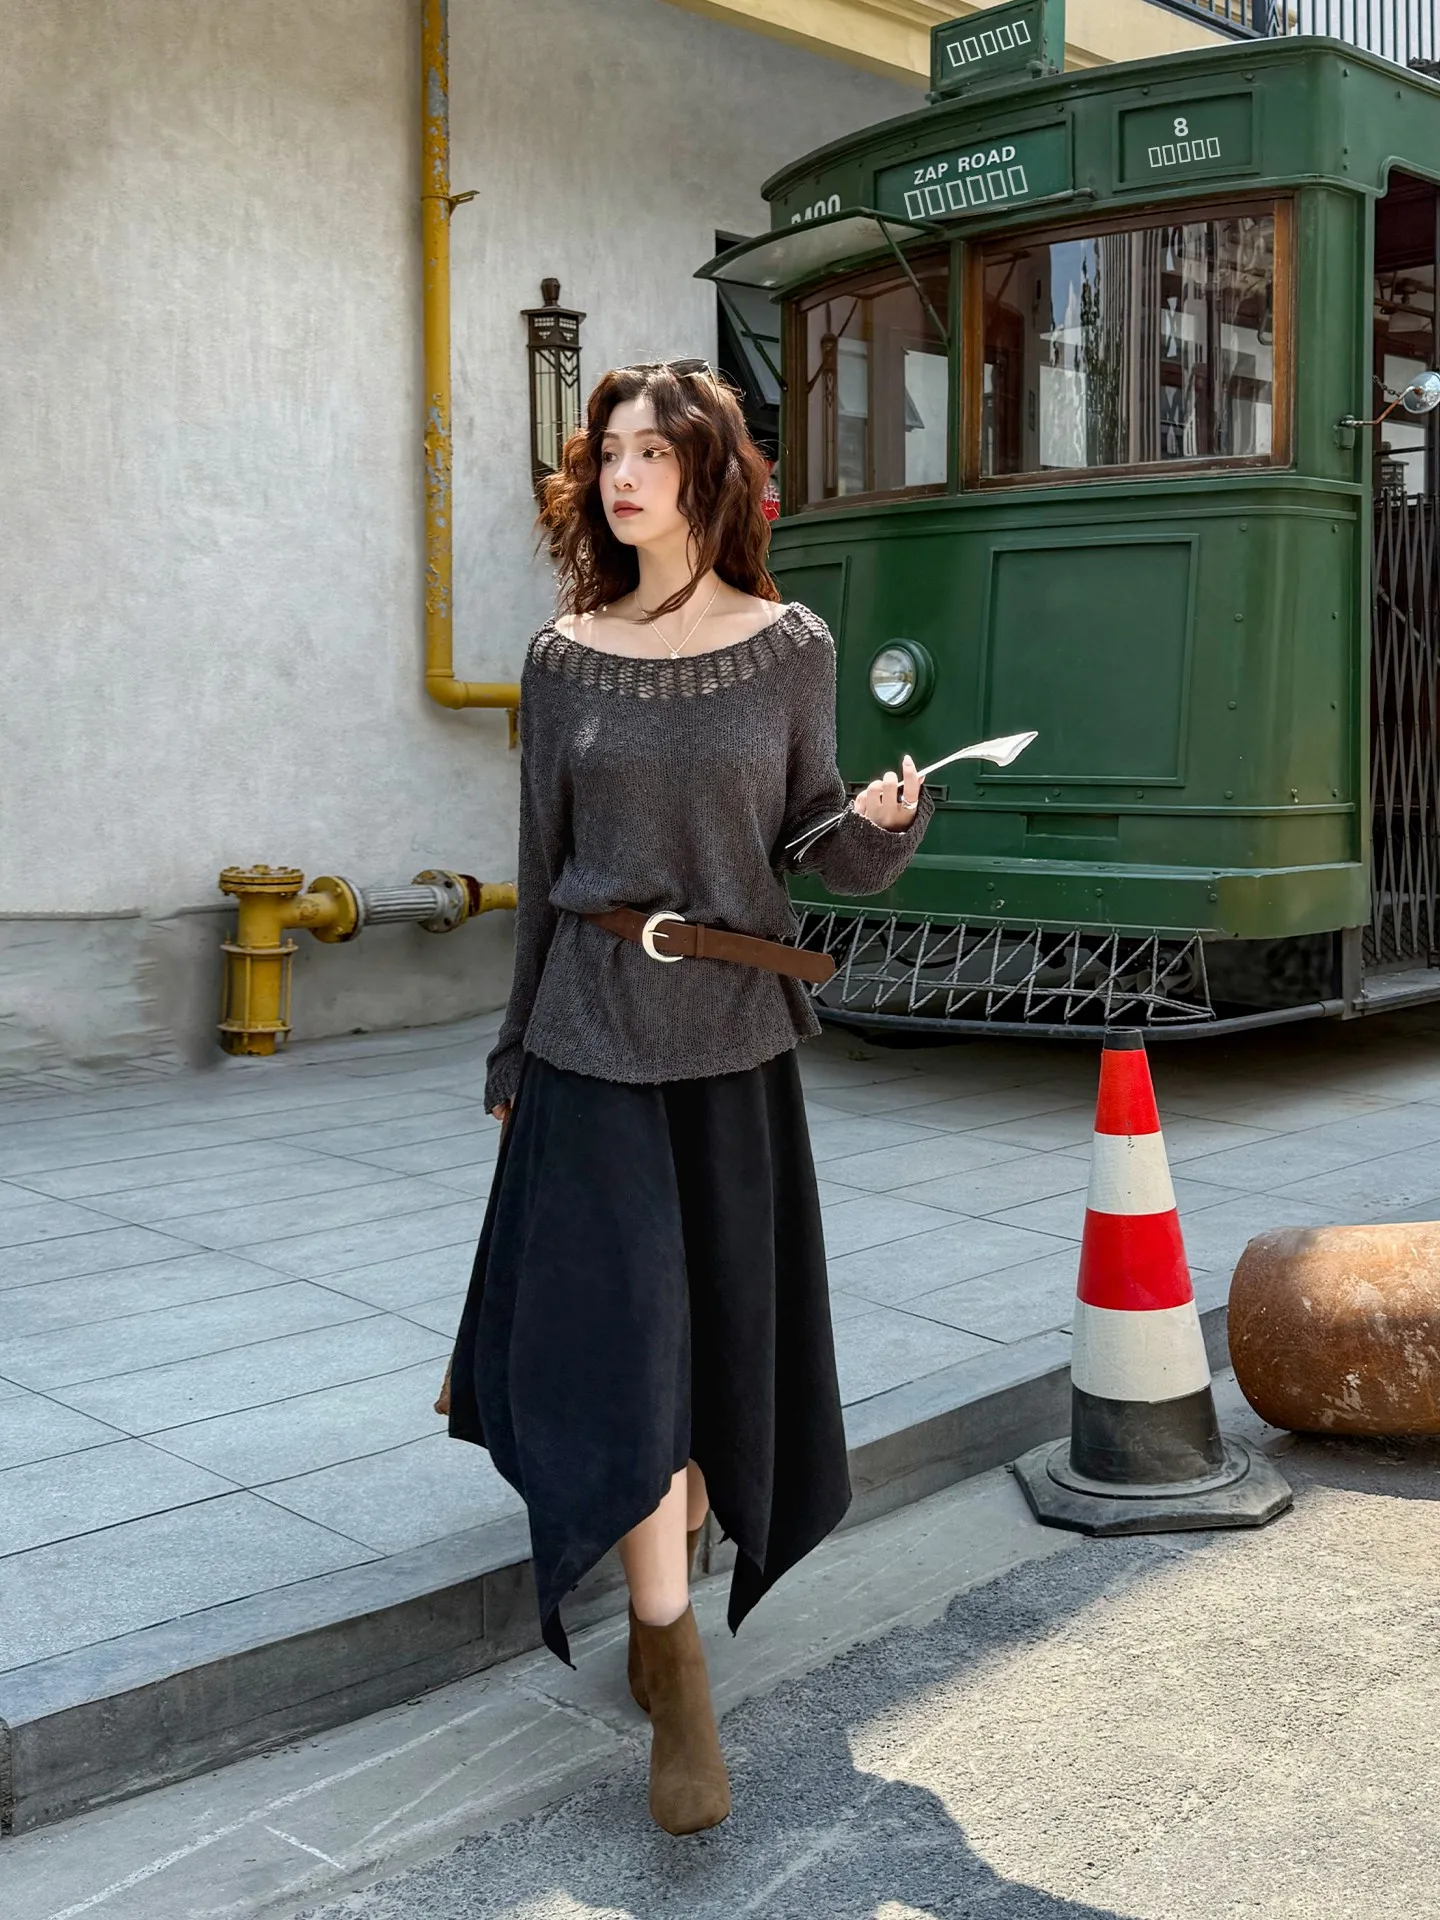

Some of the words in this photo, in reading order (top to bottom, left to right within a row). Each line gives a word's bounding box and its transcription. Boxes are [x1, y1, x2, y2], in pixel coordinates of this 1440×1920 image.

[1173, 117, 1189, 137] 8
[913, 162, 949, 185] ZAP
[957, 145, 1016, 174] ROAD
